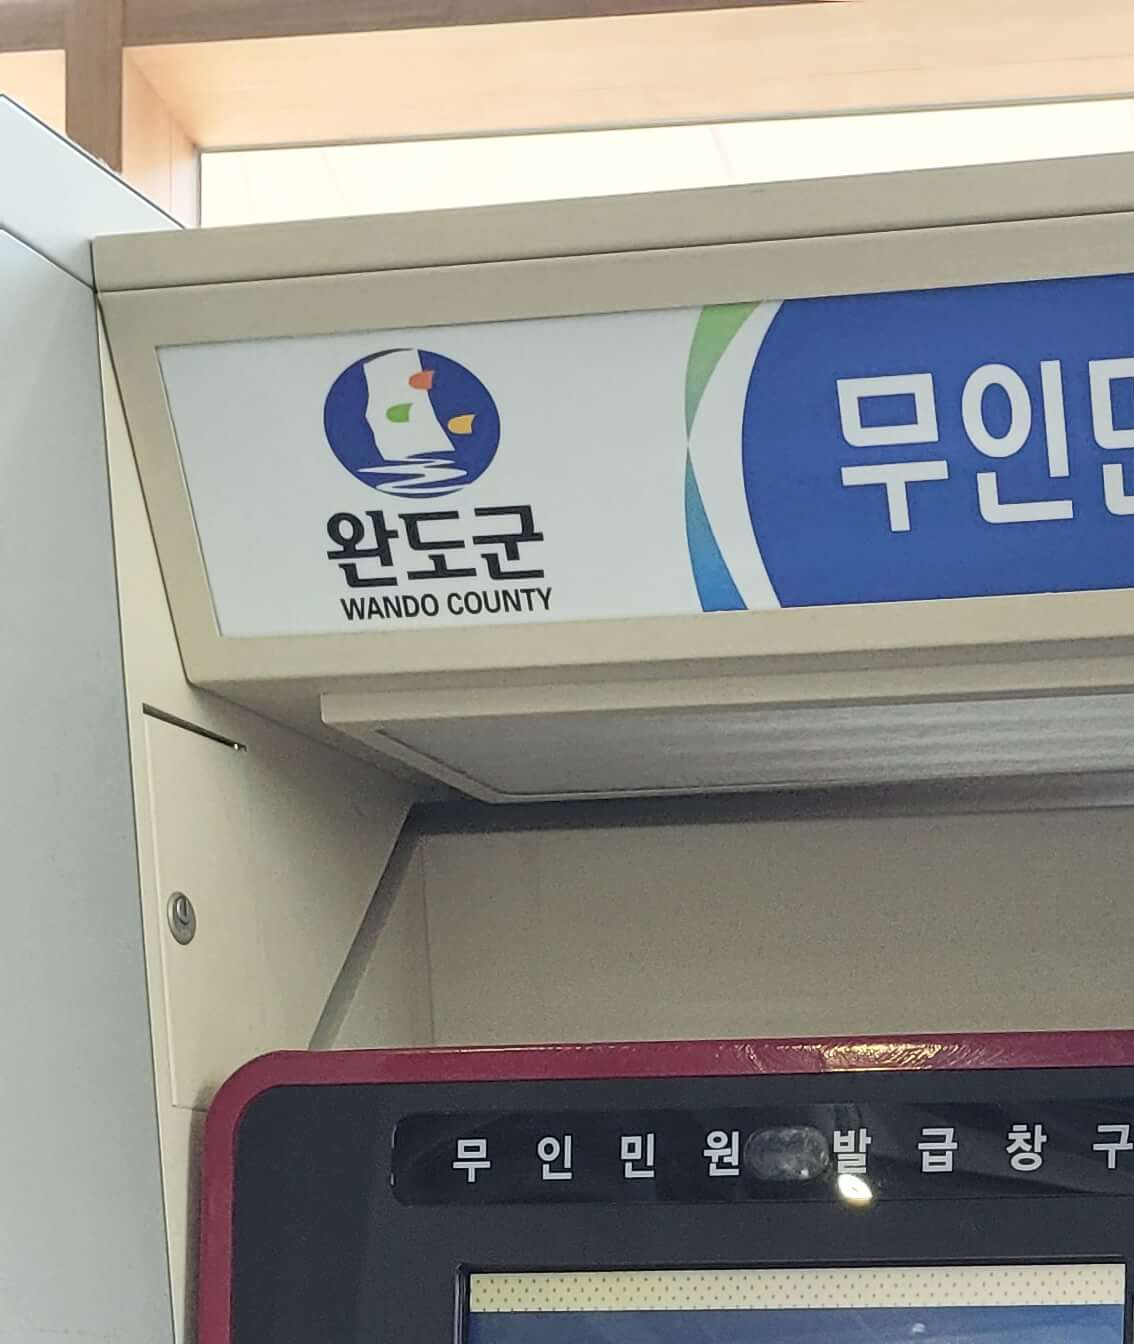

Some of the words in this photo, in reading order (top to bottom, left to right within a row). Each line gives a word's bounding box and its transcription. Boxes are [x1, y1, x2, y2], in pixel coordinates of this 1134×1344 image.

[326, 504, 545, 588] 완도군
[340, 595, 439, 622] WANDO
[446, 587, 552, 616] COUNTY
